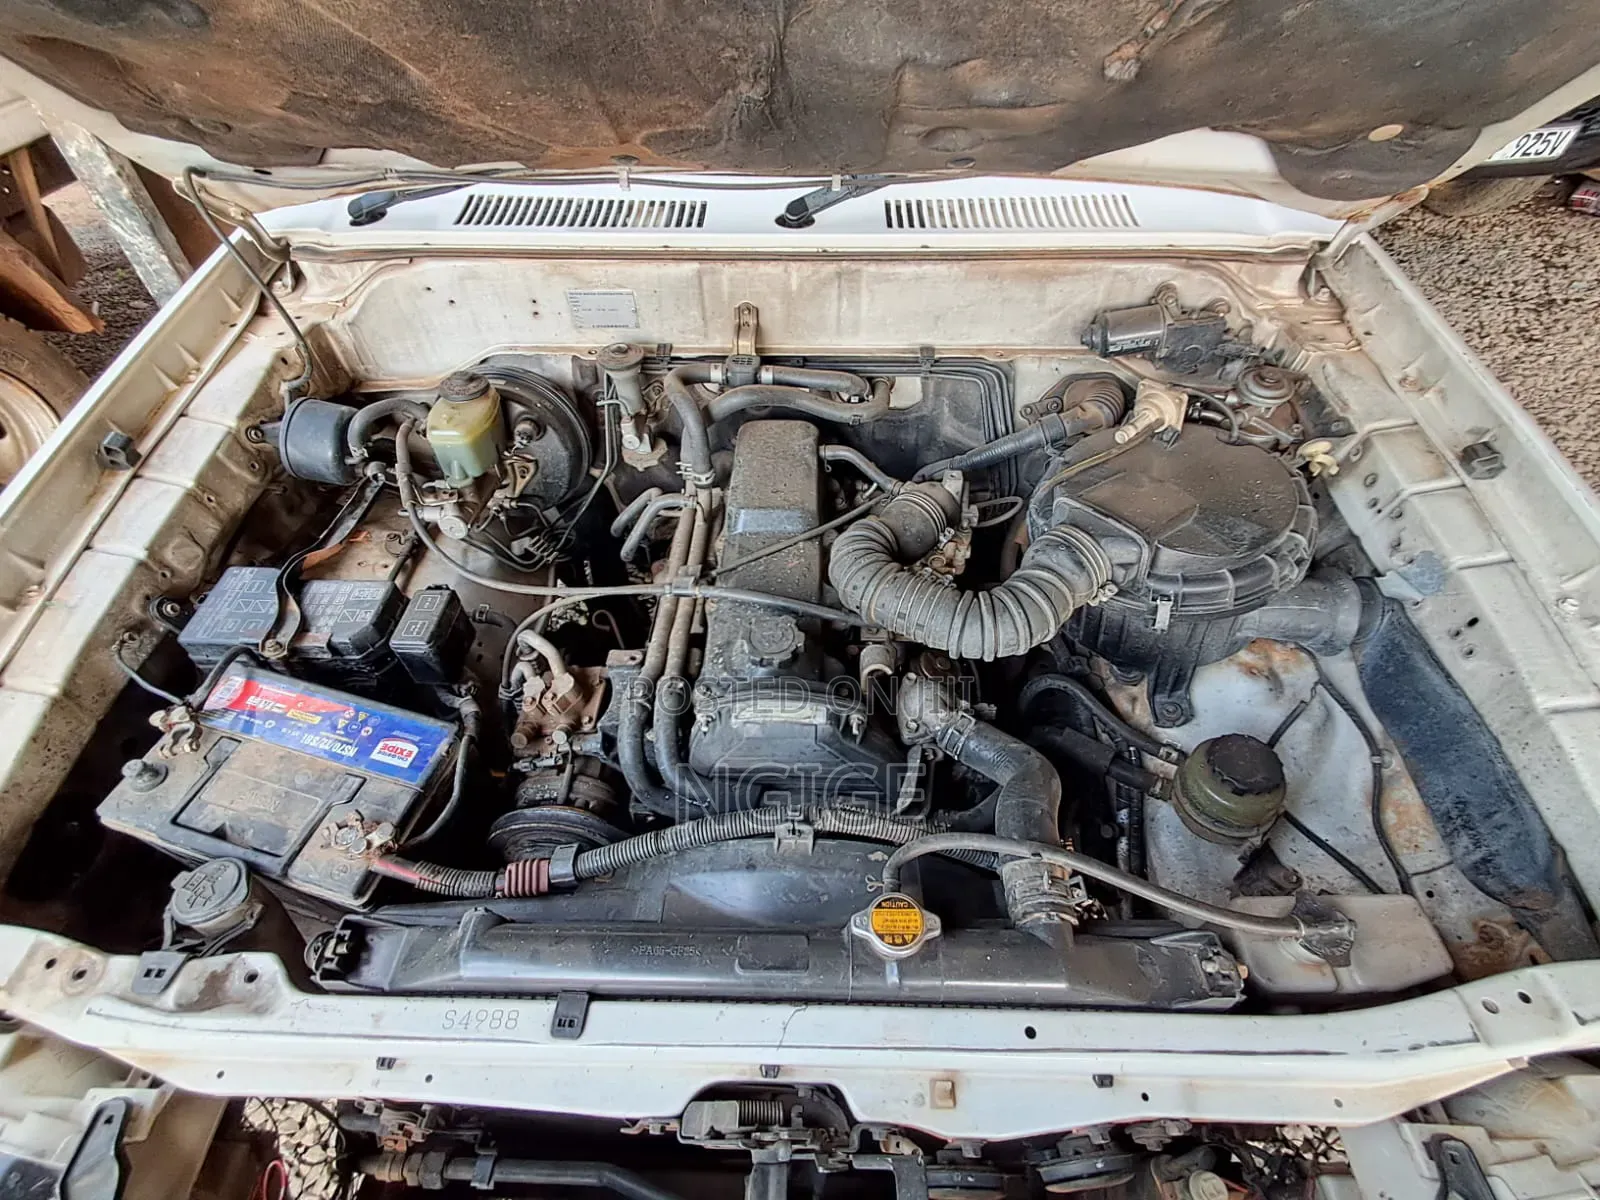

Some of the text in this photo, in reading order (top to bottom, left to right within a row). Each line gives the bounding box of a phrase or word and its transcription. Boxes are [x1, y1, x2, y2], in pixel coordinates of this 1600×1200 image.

[1510, 130, 1571, 158] 925V
[380, 742, 414, 758] EXIDE
[441, 1008, 520, 1031] S4988
